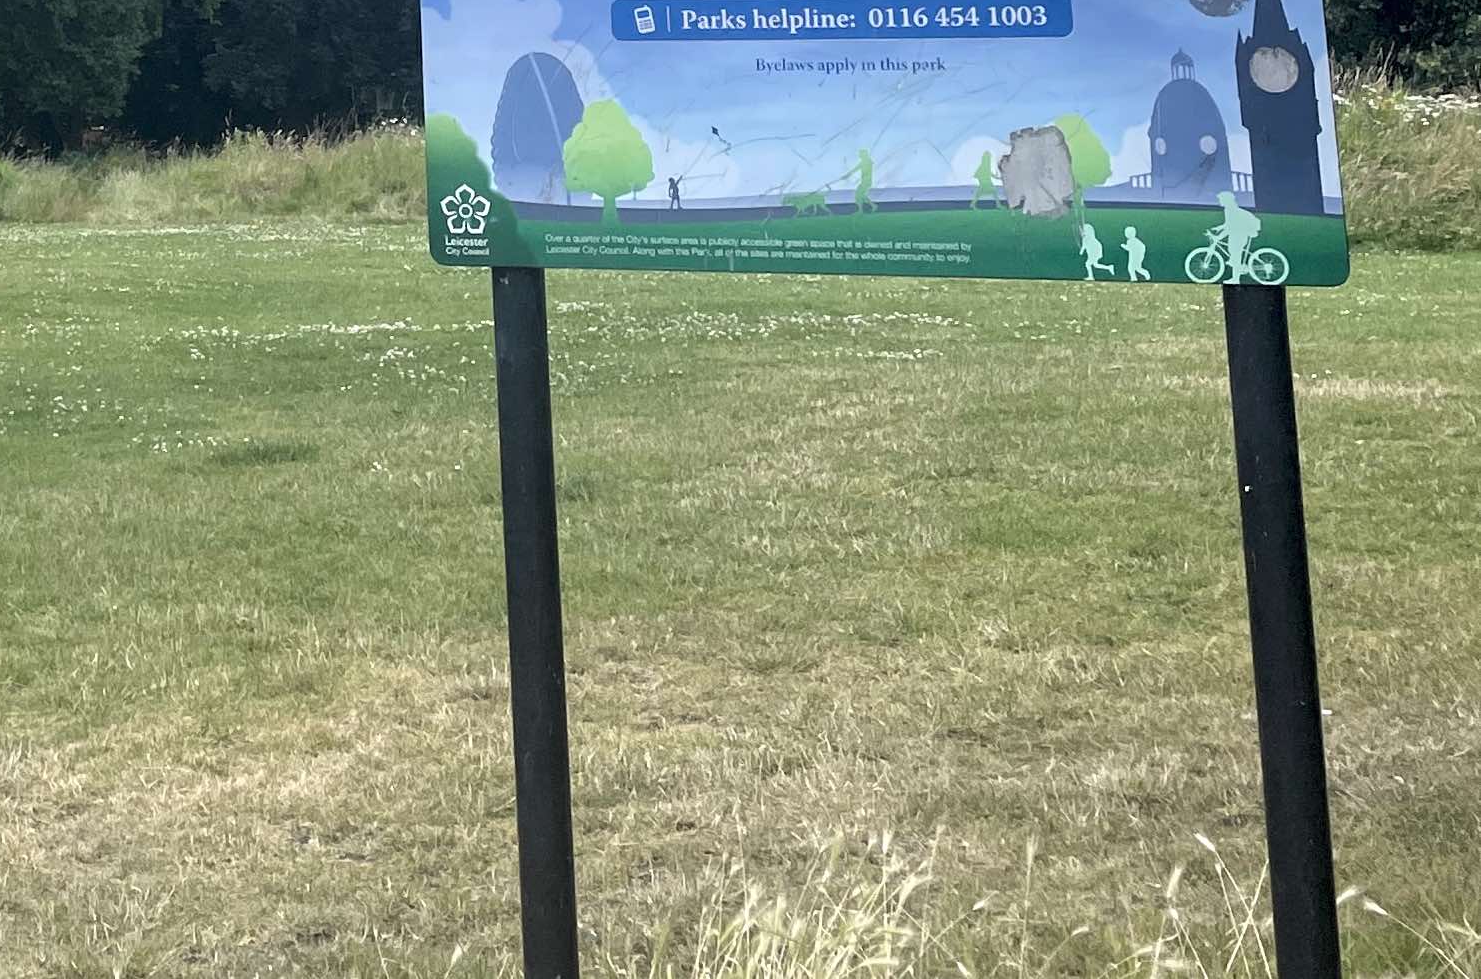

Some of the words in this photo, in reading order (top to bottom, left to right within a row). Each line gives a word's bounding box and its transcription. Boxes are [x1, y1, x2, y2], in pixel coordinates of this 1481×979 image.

[681, 9, 747, 30] Parks
[753, 7, 856, 36] helpline:
[868, 7, 928, 29] 0116
[934, 7, 980, 28] 454
[988, 5, 1048, 27] 1003
[755, 57, 815, 74] Byelaws
[818, 56, 860, 73] apply
[862, 58, 875, 70] in
[880, 56, 908, 70] this
[912, 56, 946, 74] park
[445, 235, 489, 247] Leicester
[545, 234, 564, 243] Over
[572, 236, 601, 245] quarter
[601, 235, 611, 243] of
[611, 235, 625, 244] the
[650, 236, 679, 245] surface
[681, 237, 698, 245] area
[740, 238, 783, 247] accessible
[784, 240, 808, 249] green
[810, 239, 835, 249] space
[836, 239, 853, 248] that
[863, 240, 893, 249] owned
[894, 241, 911, 249] and
[912, 241, 959, 250] maintained
[961, 242, 972, 252] by
[445, 247, 461, 257] City
[462, 247, 490, 256] Council
[545, 245, 581, 254] Leicester
[582, 245, 597, 256] City
[633, 246, 655, 257] Along
[657, 246, 674, 255] with
[675, 247, 690, 256] this
[714, 248, 723, 256] all
[725, 248, 734, 257] of
[735, 248, 748, 257] the
[750, 249, 769, 257] sites
[770, 250, 784, 258] are
[785, 249, 831, 259] maintained
[832, 251, 844, 259] for
[845, 251, 859, 260] the
[861, 251, 886, 260] whole
[887, 252, 934, 263] community
[936, 253, 945, 261] to
